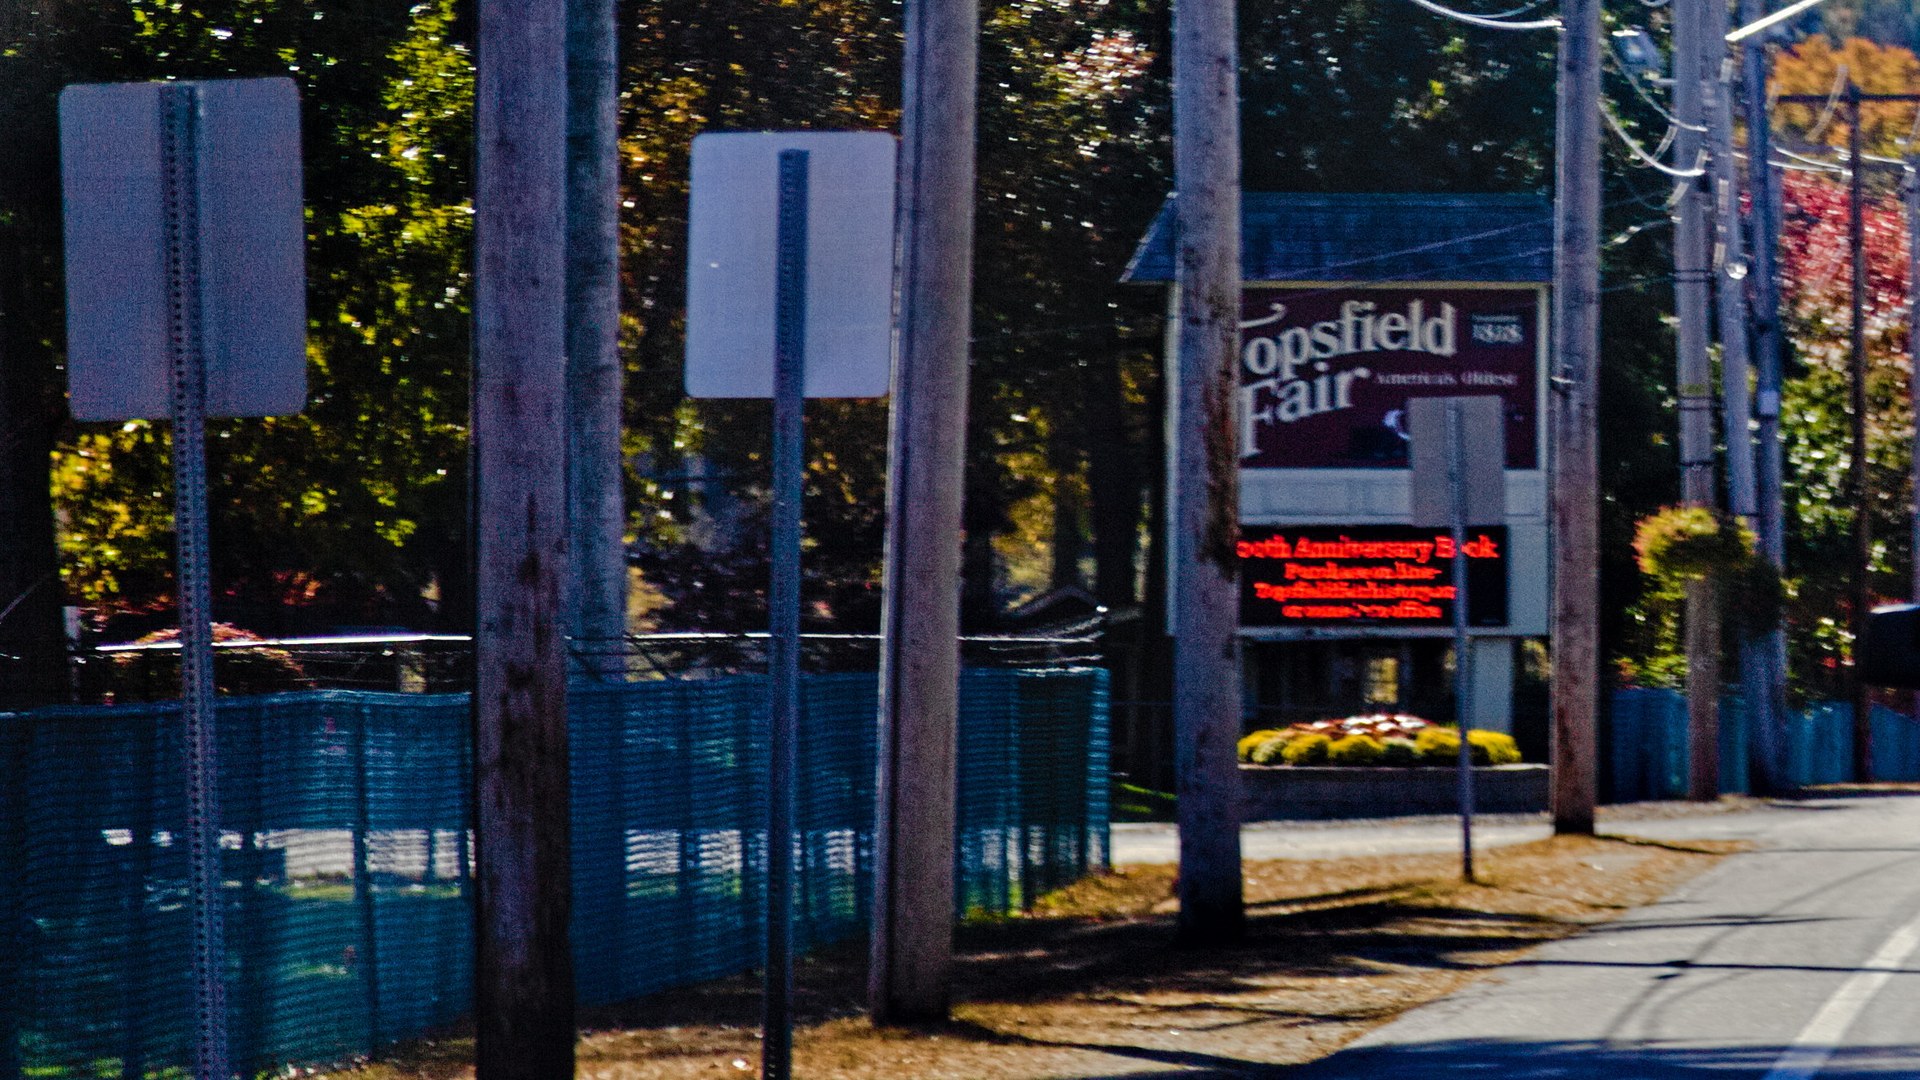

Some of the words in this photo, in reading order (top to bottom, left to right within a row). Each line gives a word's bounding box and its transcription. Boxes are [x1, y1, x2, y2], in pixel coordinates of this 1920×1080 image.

[1240, 300, 1458, 380] opsfield
[1240, 361, 1371, 458] Fair
[1294, 534, 1434, 563] Anniversary
[1435, 535, 1499, 558] Bok
